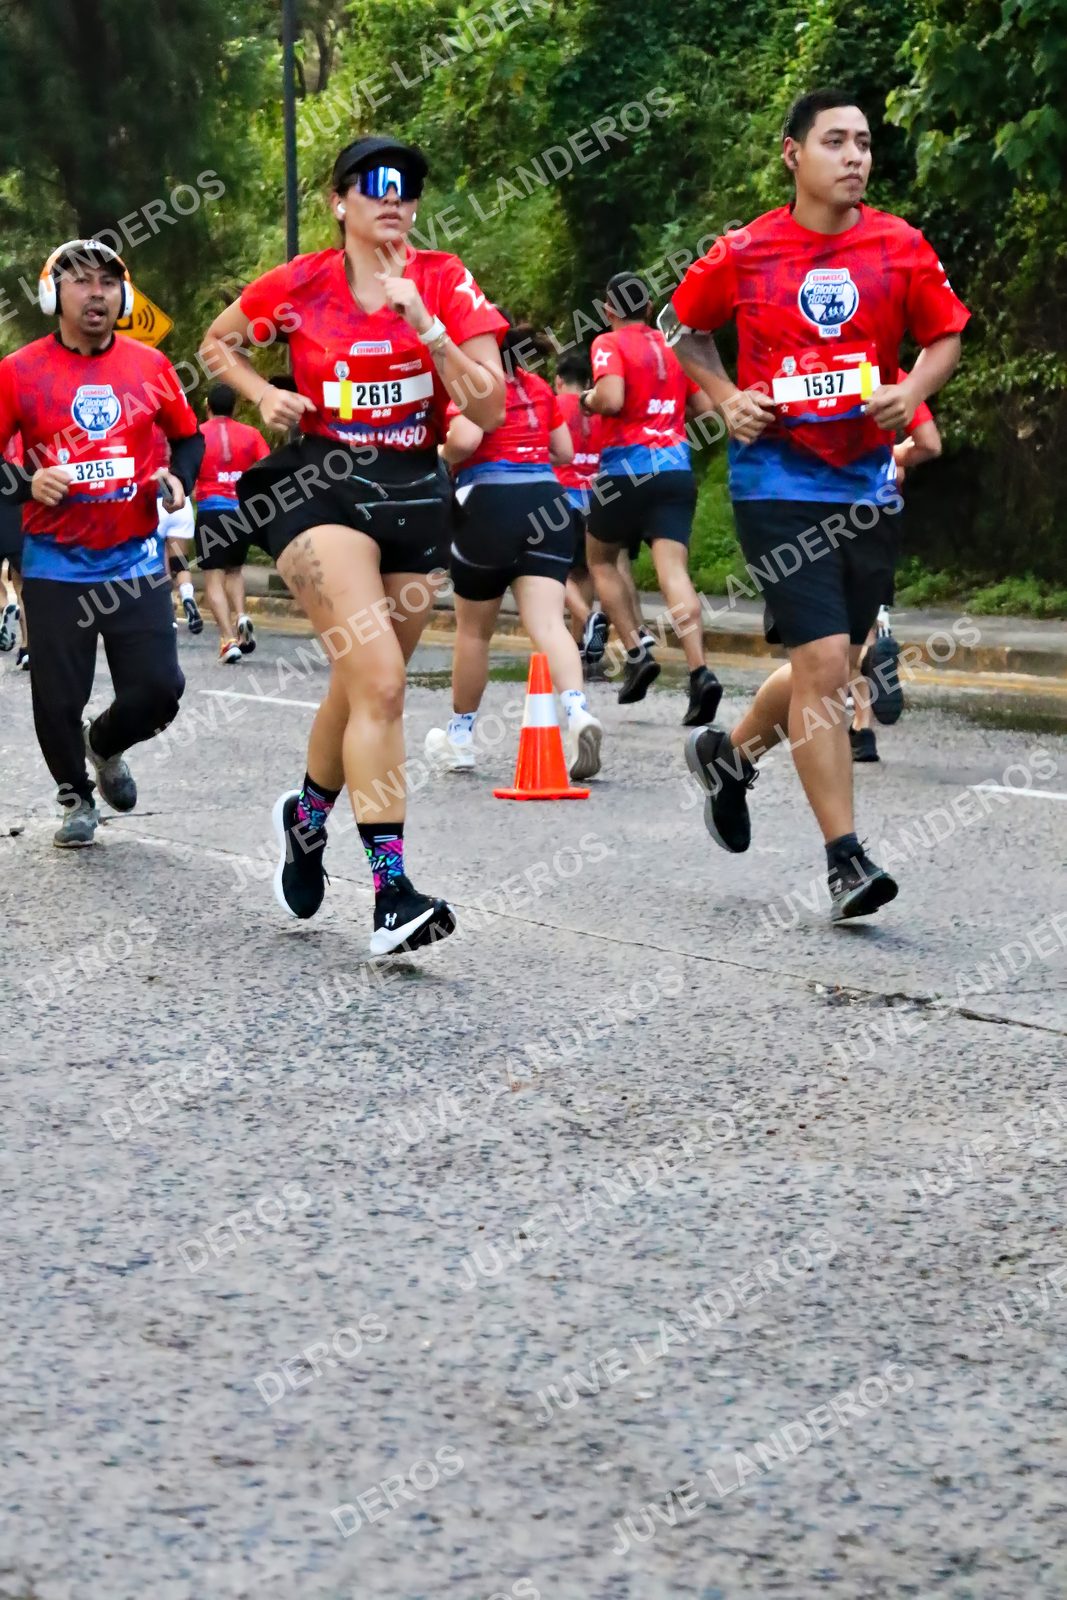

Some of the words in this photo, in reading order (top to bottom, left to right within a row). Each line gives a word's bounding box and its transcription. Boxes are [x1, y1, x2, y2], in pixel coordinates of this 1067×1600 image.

[807, 293, 833, 304] Race
[814, 284, 844, 295] Global
[356, 381, 402, 406] 2613
[803, 372, 844, 397] 1537
[75, 460, 114, 481] 3255
